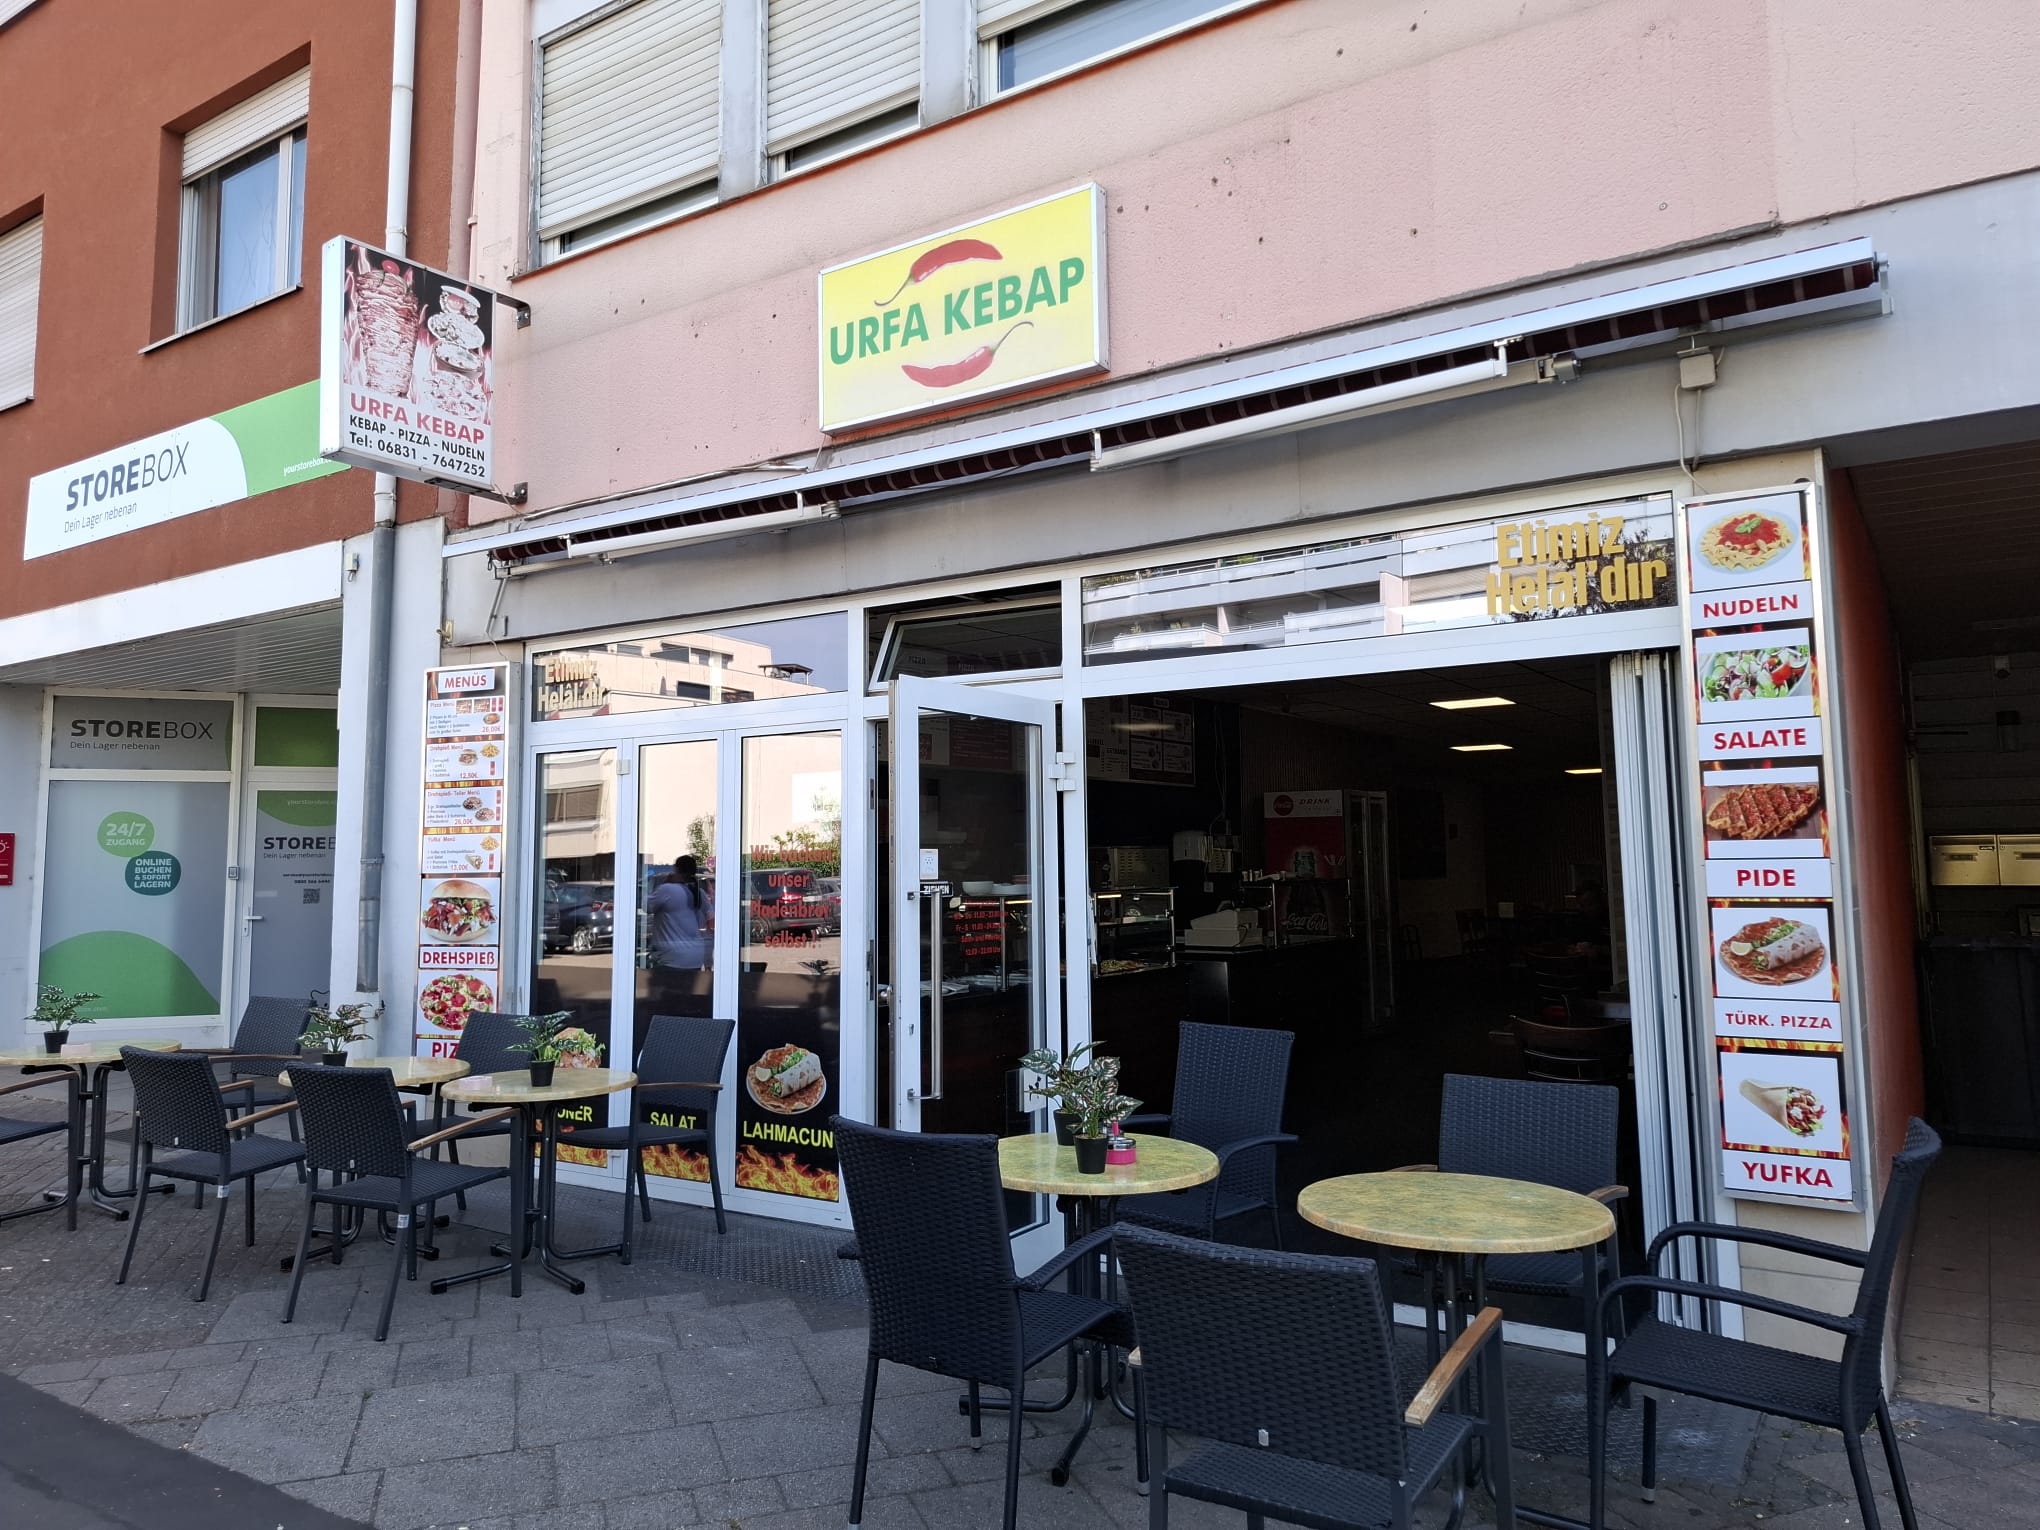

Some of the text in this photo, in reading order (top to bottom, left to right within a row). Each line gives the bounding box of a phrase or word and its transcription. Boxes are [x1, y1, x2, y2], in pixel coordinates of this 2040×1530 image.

[830, 257, 1085, 365] URFA KEBAP
[351, 393, 485, 444] URFA KEBAP
[350, 414, 387, 434] KEBAP
[398, 428, 430, 447] PIZZA
[442, 440, 485, 461] NUDELN
[350, 432, 373, 448] Tel:
[377, 439, 416, 460] 06831
[432, 453, 486, 477] 7647252
[66, 441, 190, 512] STOREBOX
[64, 502, 138, 533] Dein Lager nebenan
[1497, 511, 1626, 568] Etimiz
[1703, 594, 1799, 619] NUDELN
[444, 671, 487, 689] MENÜS
[71, 719, 214, 740] STOREBOX
[1713, 728, 1806, 750] SALATE
[70, 741, 161, 751] Dein Lager nebenan
[106, 821, 146, 838] 24/7
[106, 838, 146, 846] ZUGANG
[263, 836, 337, 850] STOREB
[135, 858, 172, 866] ONLINE
[751, 845, 775, 862] Wir
[134, 866, 172, 874] BUCHEN
[1736, 868, 1796, 887] PIDE
[134, 880, 172, 888] LAGERN
[768, 873, 810, 888] unser
[750, 900, 830, 918] Fladenbrot
[764, 930, 808, 948] selbst
[1725, 1010, 1832, 1029] TÜRK. PIZZA
[743, 1120, 834, 1149] LAHMACUN
[1742, 1161, 1833, 1188] YUFKA
